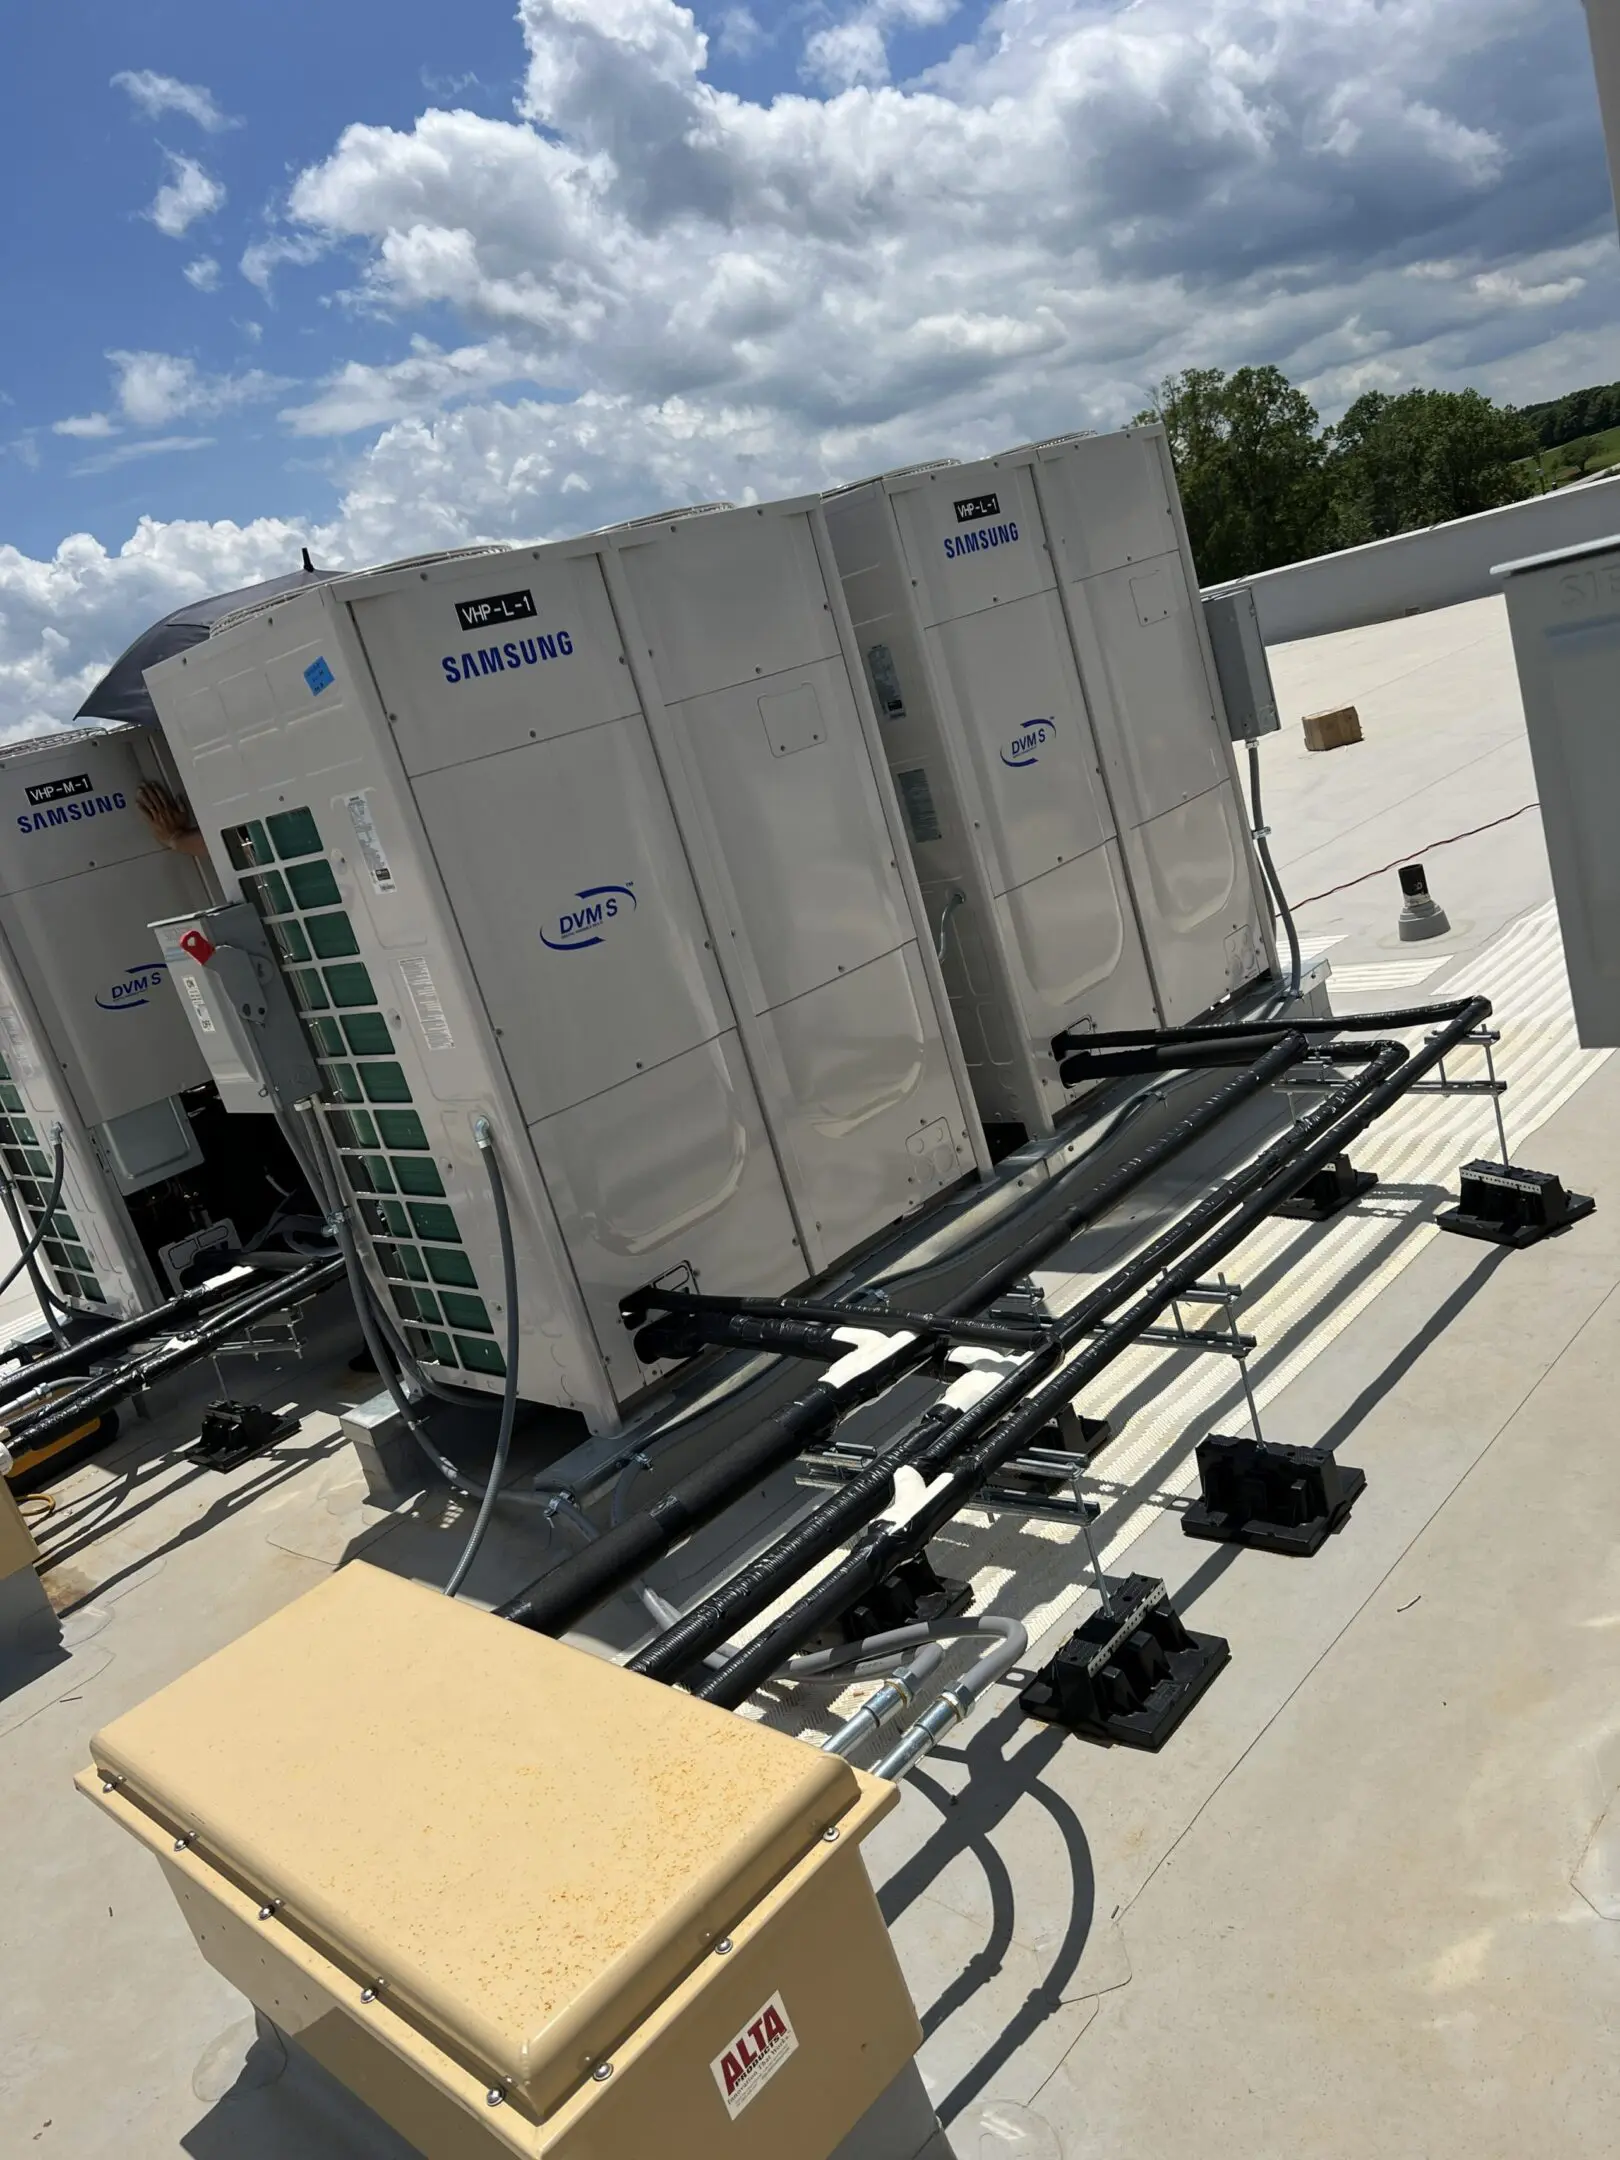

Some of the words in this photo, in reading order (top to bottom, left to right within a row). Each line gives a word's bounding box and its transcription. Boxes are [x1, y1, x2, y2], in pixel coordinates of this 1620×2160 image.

[957, 497, 998, 519] VHP-L-1
[944, 522, 1019, 558] SAMSUNG
[461, 595, 532, 625] VHP-L-1
[441, 630, 574, 683] SAMSUNG
[1011, 732, 1036, 755] DVM
[29, 777, 91, 802] VHP-M-1
[16, 792, 127, 833] SAMSUNG
[559, 903, 603, 935] DVM
[605, 898, 618, 917] S
[111, 977, 149, 1000] DVM
[720, 2004, 788, 2097] ALTA
[734, 2033, 781, 2087] PRODUCTS
